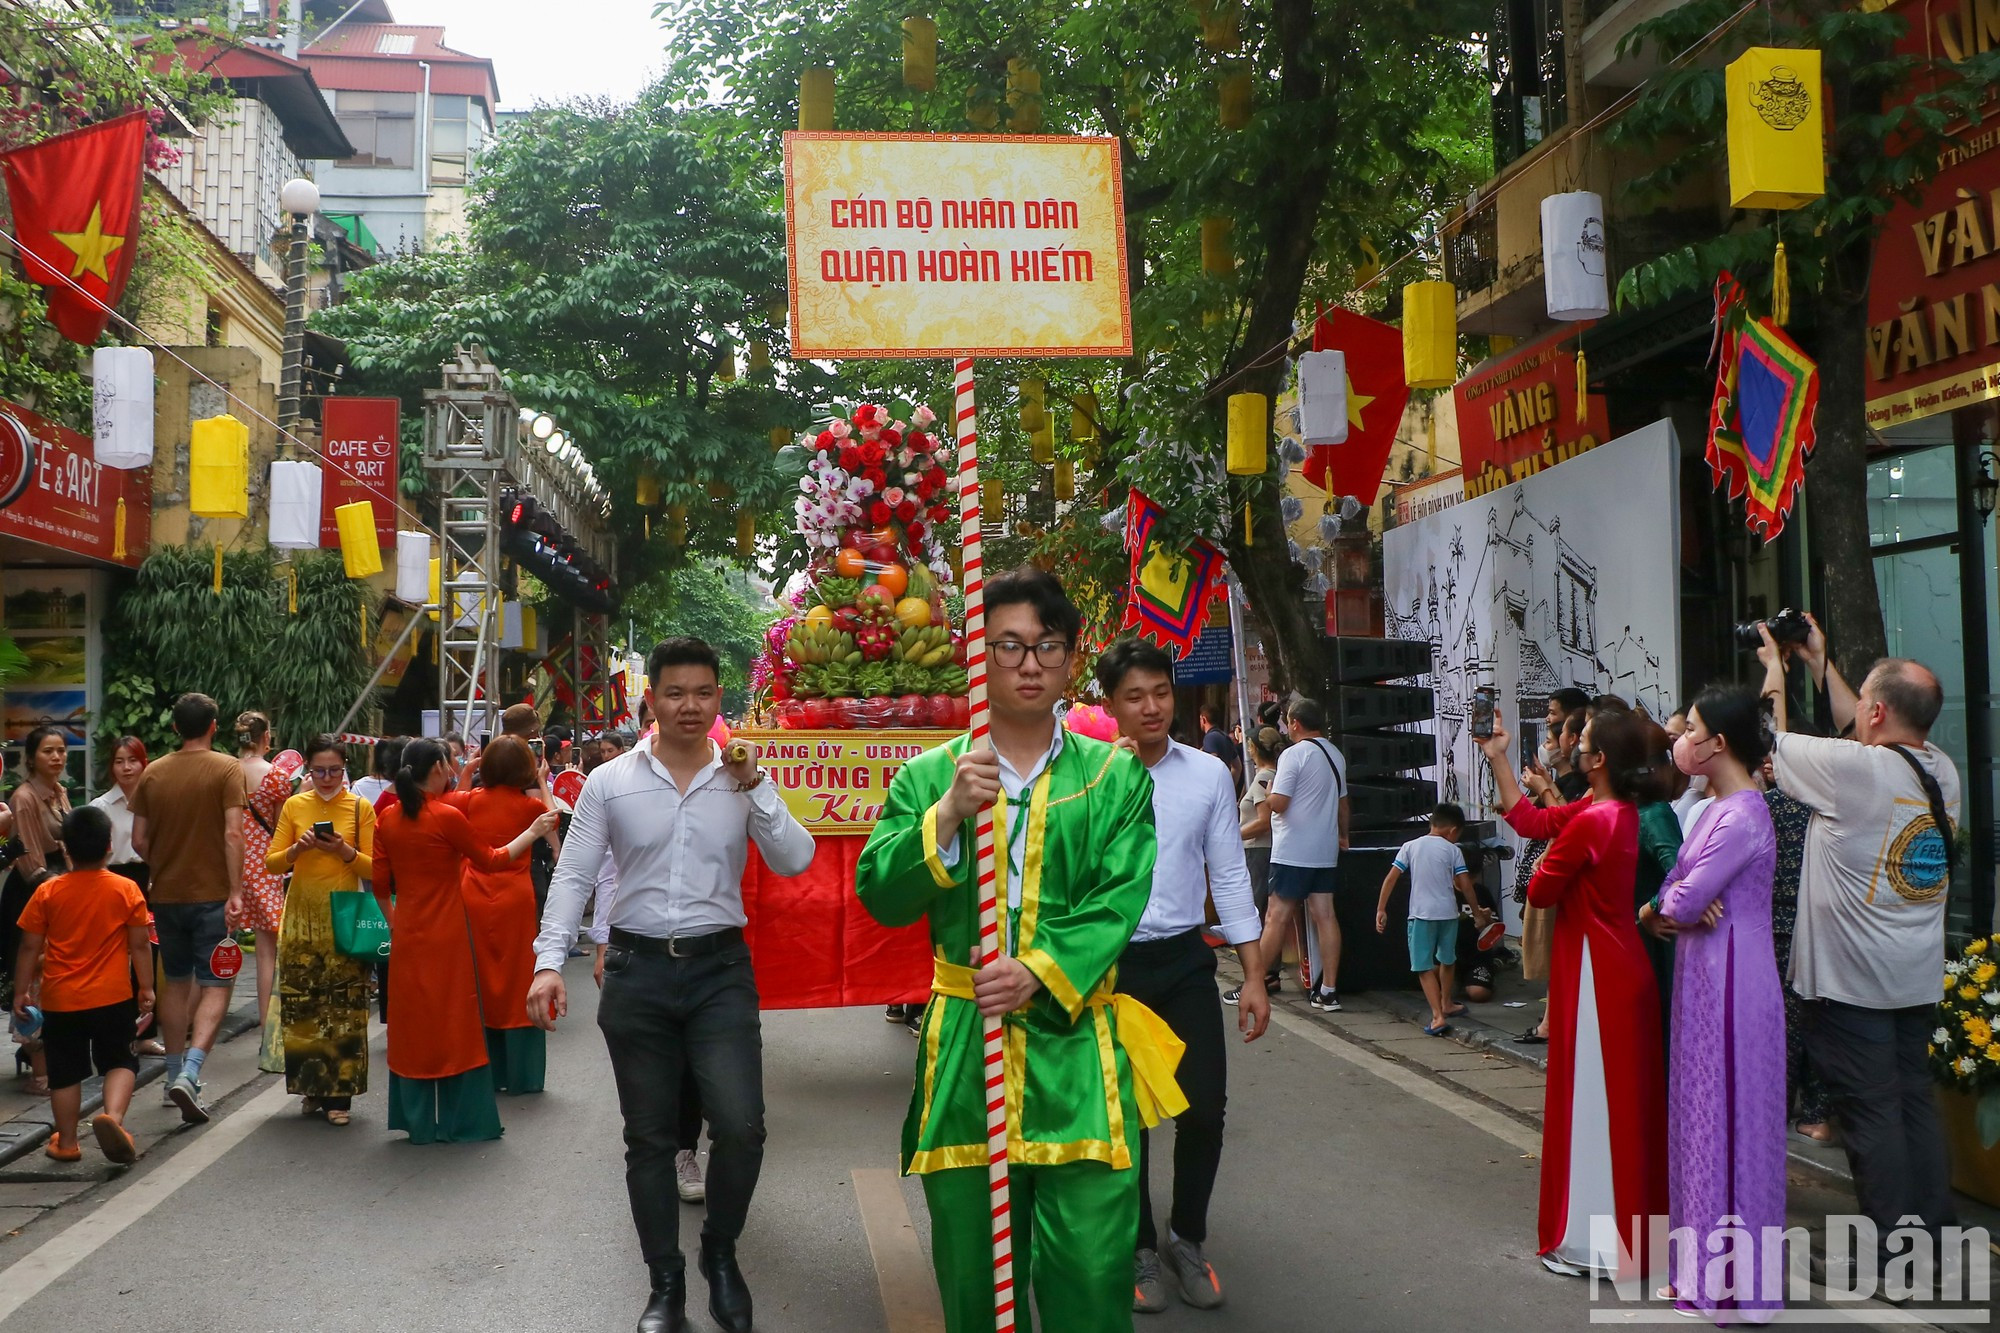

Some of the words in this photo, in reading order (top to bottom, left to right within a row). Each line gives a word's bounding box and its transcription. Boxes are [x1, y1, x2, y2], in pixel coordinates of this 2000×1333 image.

[831, 192, 887, 229] CÁN
[896, 196, 932, 234] BỘ
[942, 197, 1015, 229] NHÂN
[1024, 198, 1079, 229] DÂN
[820, 246, 907, 288] QUẬN
[917, 241, 1001, 282] HOÀN
[1011, 242, 1094, 282] KIẾM
[1866, 296, 1970, 381] VĂN
[1914, 393, 1940, 410] Hoàn
[1972, 378, 1986, 393] Hà
[1489, 382, 1551, 441] VÀNG
[329, 440, 367, 456] CAFE
[54, 466, 63, 495] &
[66, 452, 103, 508] ART
[344, 461, 350, 469] &
[355, 461, 385, 476] ART
[817, 740, 843, 759] ỦY
[866, 745, 923, 759] UBND
[764, 761, 870, 789] ƯỜNG
[803, 793, 885, 823] Kín
